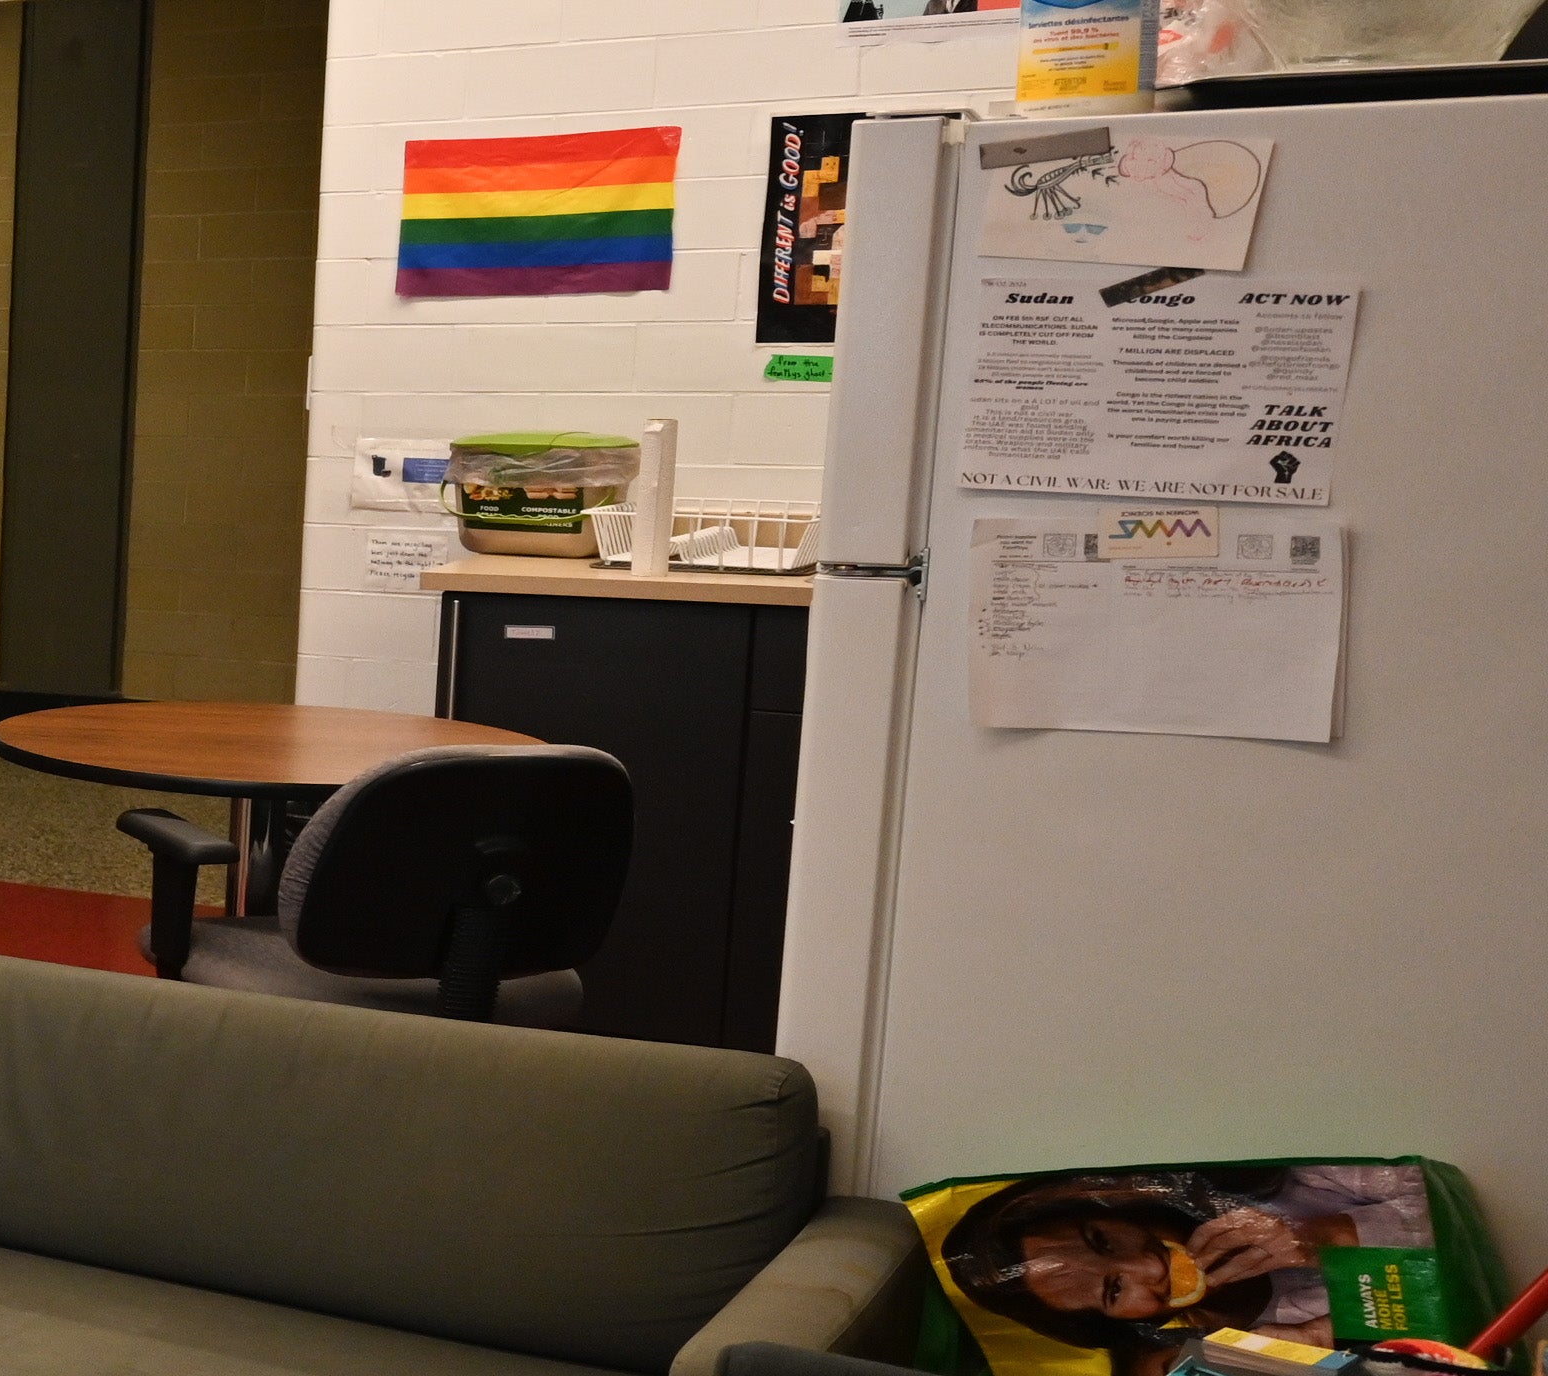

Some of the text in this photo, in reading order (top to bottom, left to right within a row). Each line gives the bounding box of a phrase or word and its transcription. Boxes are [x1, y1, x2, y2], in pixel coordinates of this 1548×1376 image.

[1005, 292, 1074, 306] Sudan
[1238, 292, 1351, 307] ACT NOW
[1264, 403, 1328, 418] TALK
[1250, 418, 1333, 433] ABOUT
[1245, 434, 1332, 449] AFRICA
[962, 471, 1323, 500] NOT A CIVIL WAR: WE ARE NOT FOR SALE
[521, 506, 577, 515] COMPOSTABLE
[1357, 1273, 1379, 1329] ALWAYS
[1385, 1264, 1409, 1331] FOR LESS
[1373, 1288, 1393, 1330] MORE
